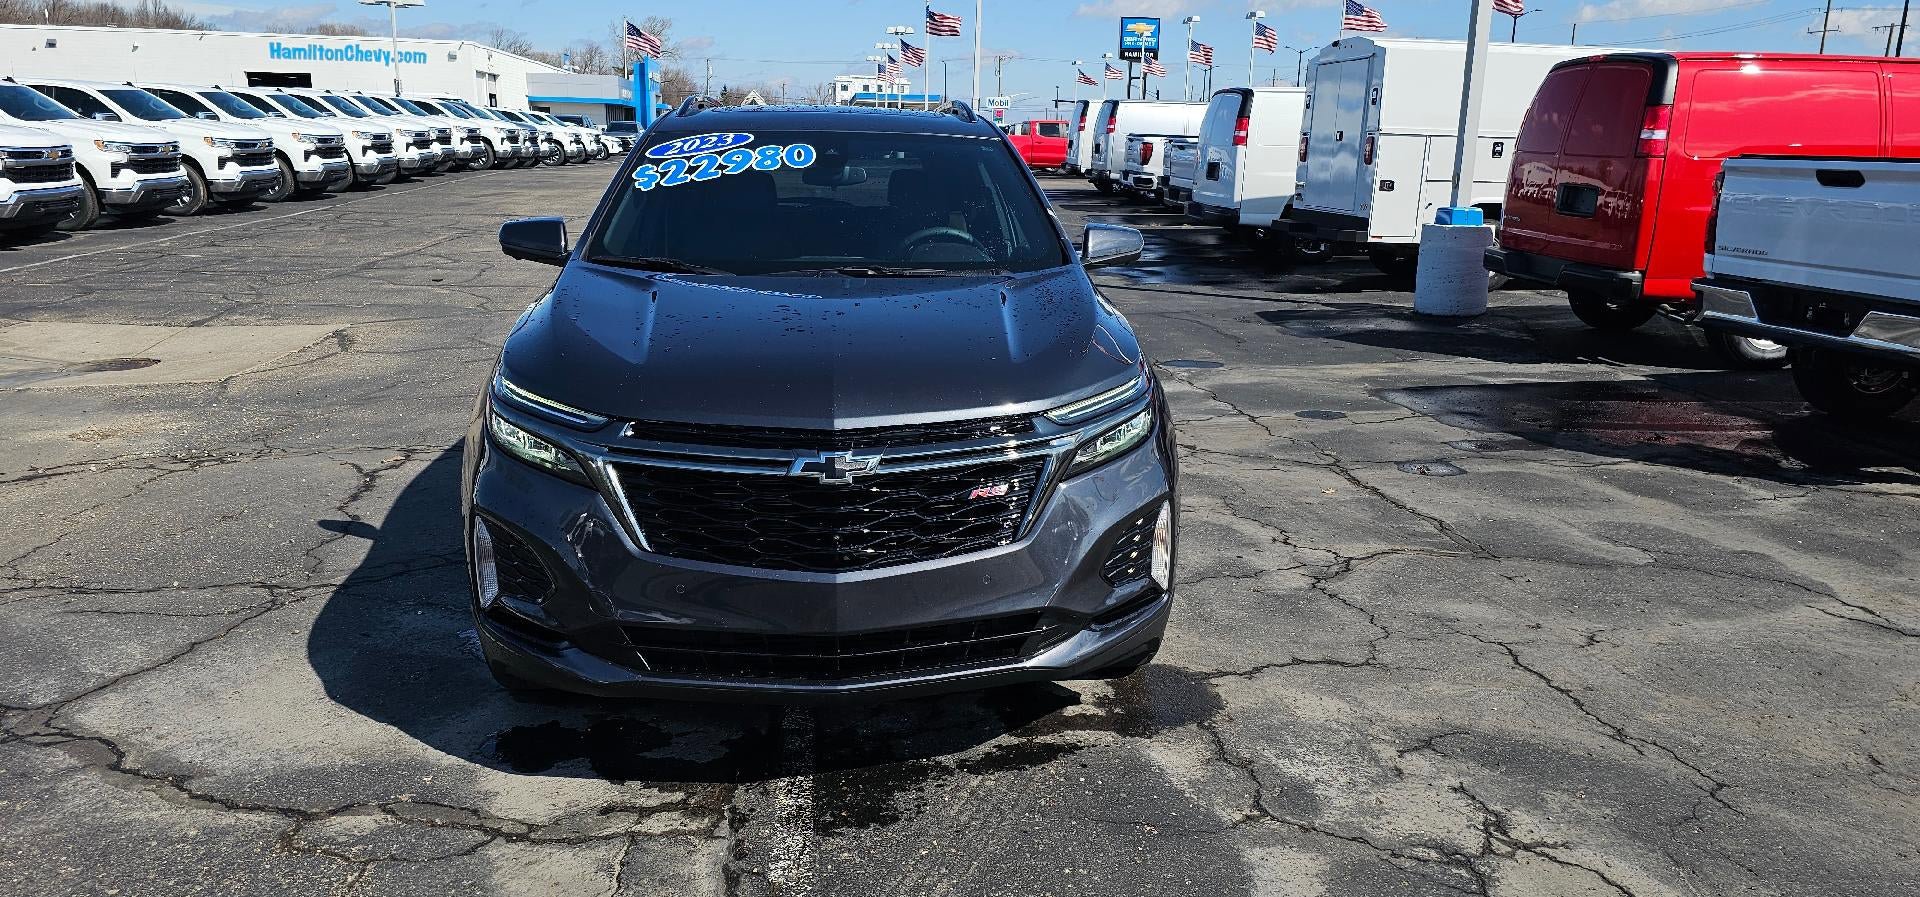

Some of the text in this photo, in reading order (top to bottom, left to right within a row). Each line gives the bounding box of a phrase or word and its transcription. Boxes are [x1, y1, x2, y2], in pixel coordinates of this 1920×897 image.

[269, 42, 427, 66] HamiltonChevy.com
[988, 99, 1009, 107] Mobil
[664, 134, 735, 156] 2023
[632, 144, 816, 191] $22980
[968, 484, 1009, 499] RS
